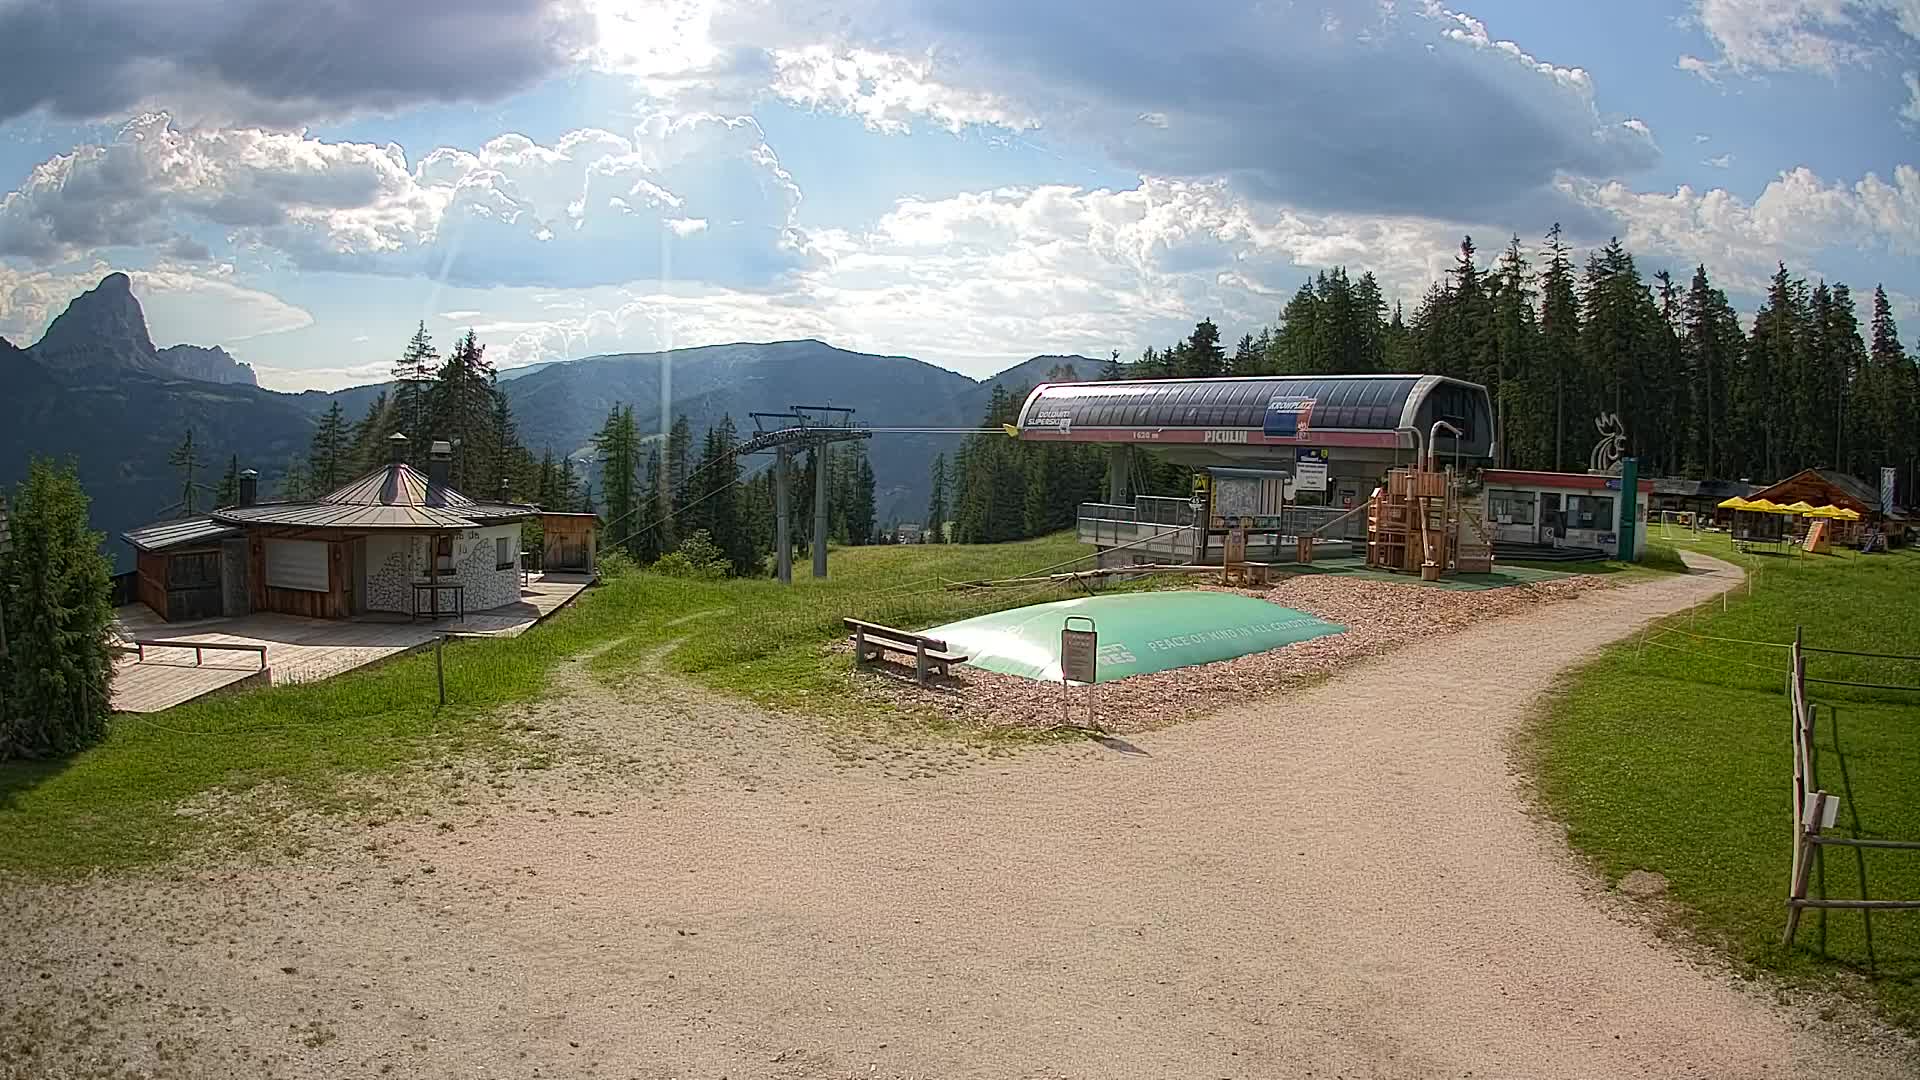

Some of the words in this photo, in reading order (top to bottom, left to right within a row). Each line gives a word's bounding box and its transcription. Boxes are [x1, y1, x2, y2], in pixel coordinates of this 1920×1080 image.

[1268, 401, 1314, 410] KRONPLATZ
[1204, 430, 1248, 443] PICULIN
[1148, 635, 1191, 652] PEACE
[1190, 633, 1206, 643] OF
[1207, 628, 1238, 641] MIND
